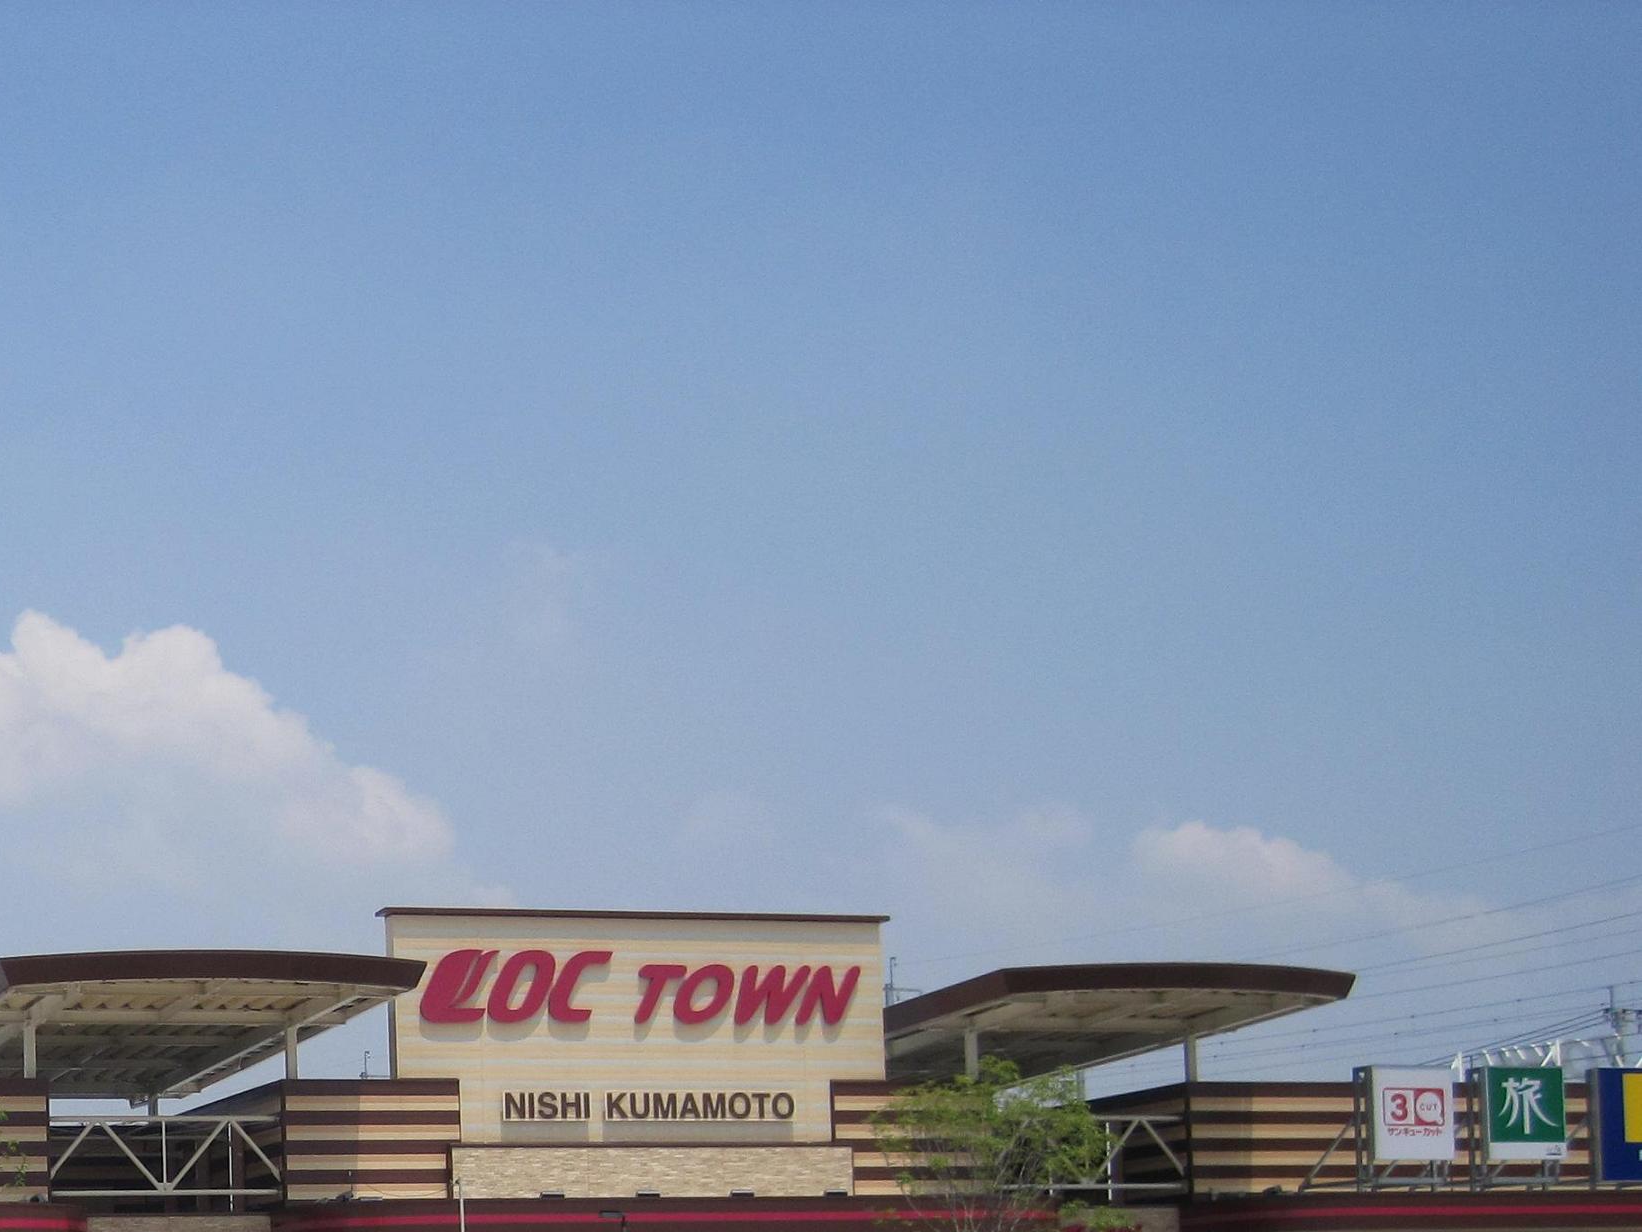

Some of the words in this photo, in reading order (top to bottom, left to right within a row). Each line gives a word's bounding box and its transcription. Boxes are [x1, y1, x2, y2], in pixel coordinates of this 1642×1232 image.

[633, 963, 861, 1026] TOWN
[503, 1091, 591, 1121] NISHI
[605, 1091, 796, 1121] KUMAMOTO
[1419, 1104, 1439, 1112] CUT
[1499, 1077, 1558, 1135] 旅
[1387, 1127, 1443, 1137] サンキューカット
